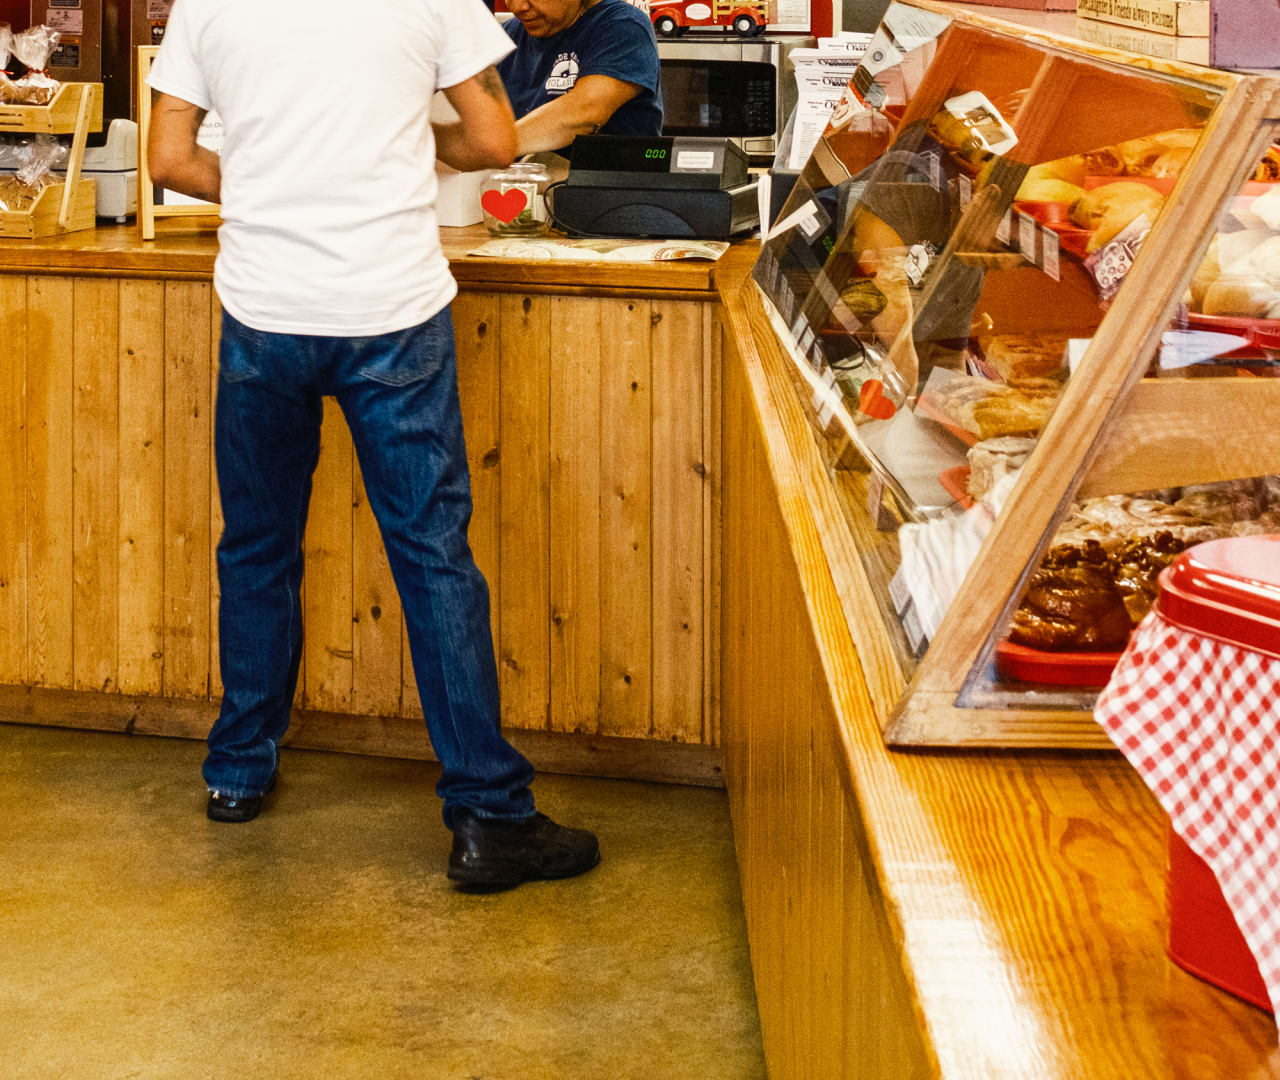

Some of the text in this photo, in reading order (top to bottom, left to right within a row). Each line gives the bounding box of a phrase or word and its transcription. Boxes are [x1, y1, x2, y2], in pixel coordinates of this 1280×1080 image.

[1114, 0, 1132, 20] Friends
[1132, 3, 1150, 27] always
[1151, 7, 1174, 29] welcome
